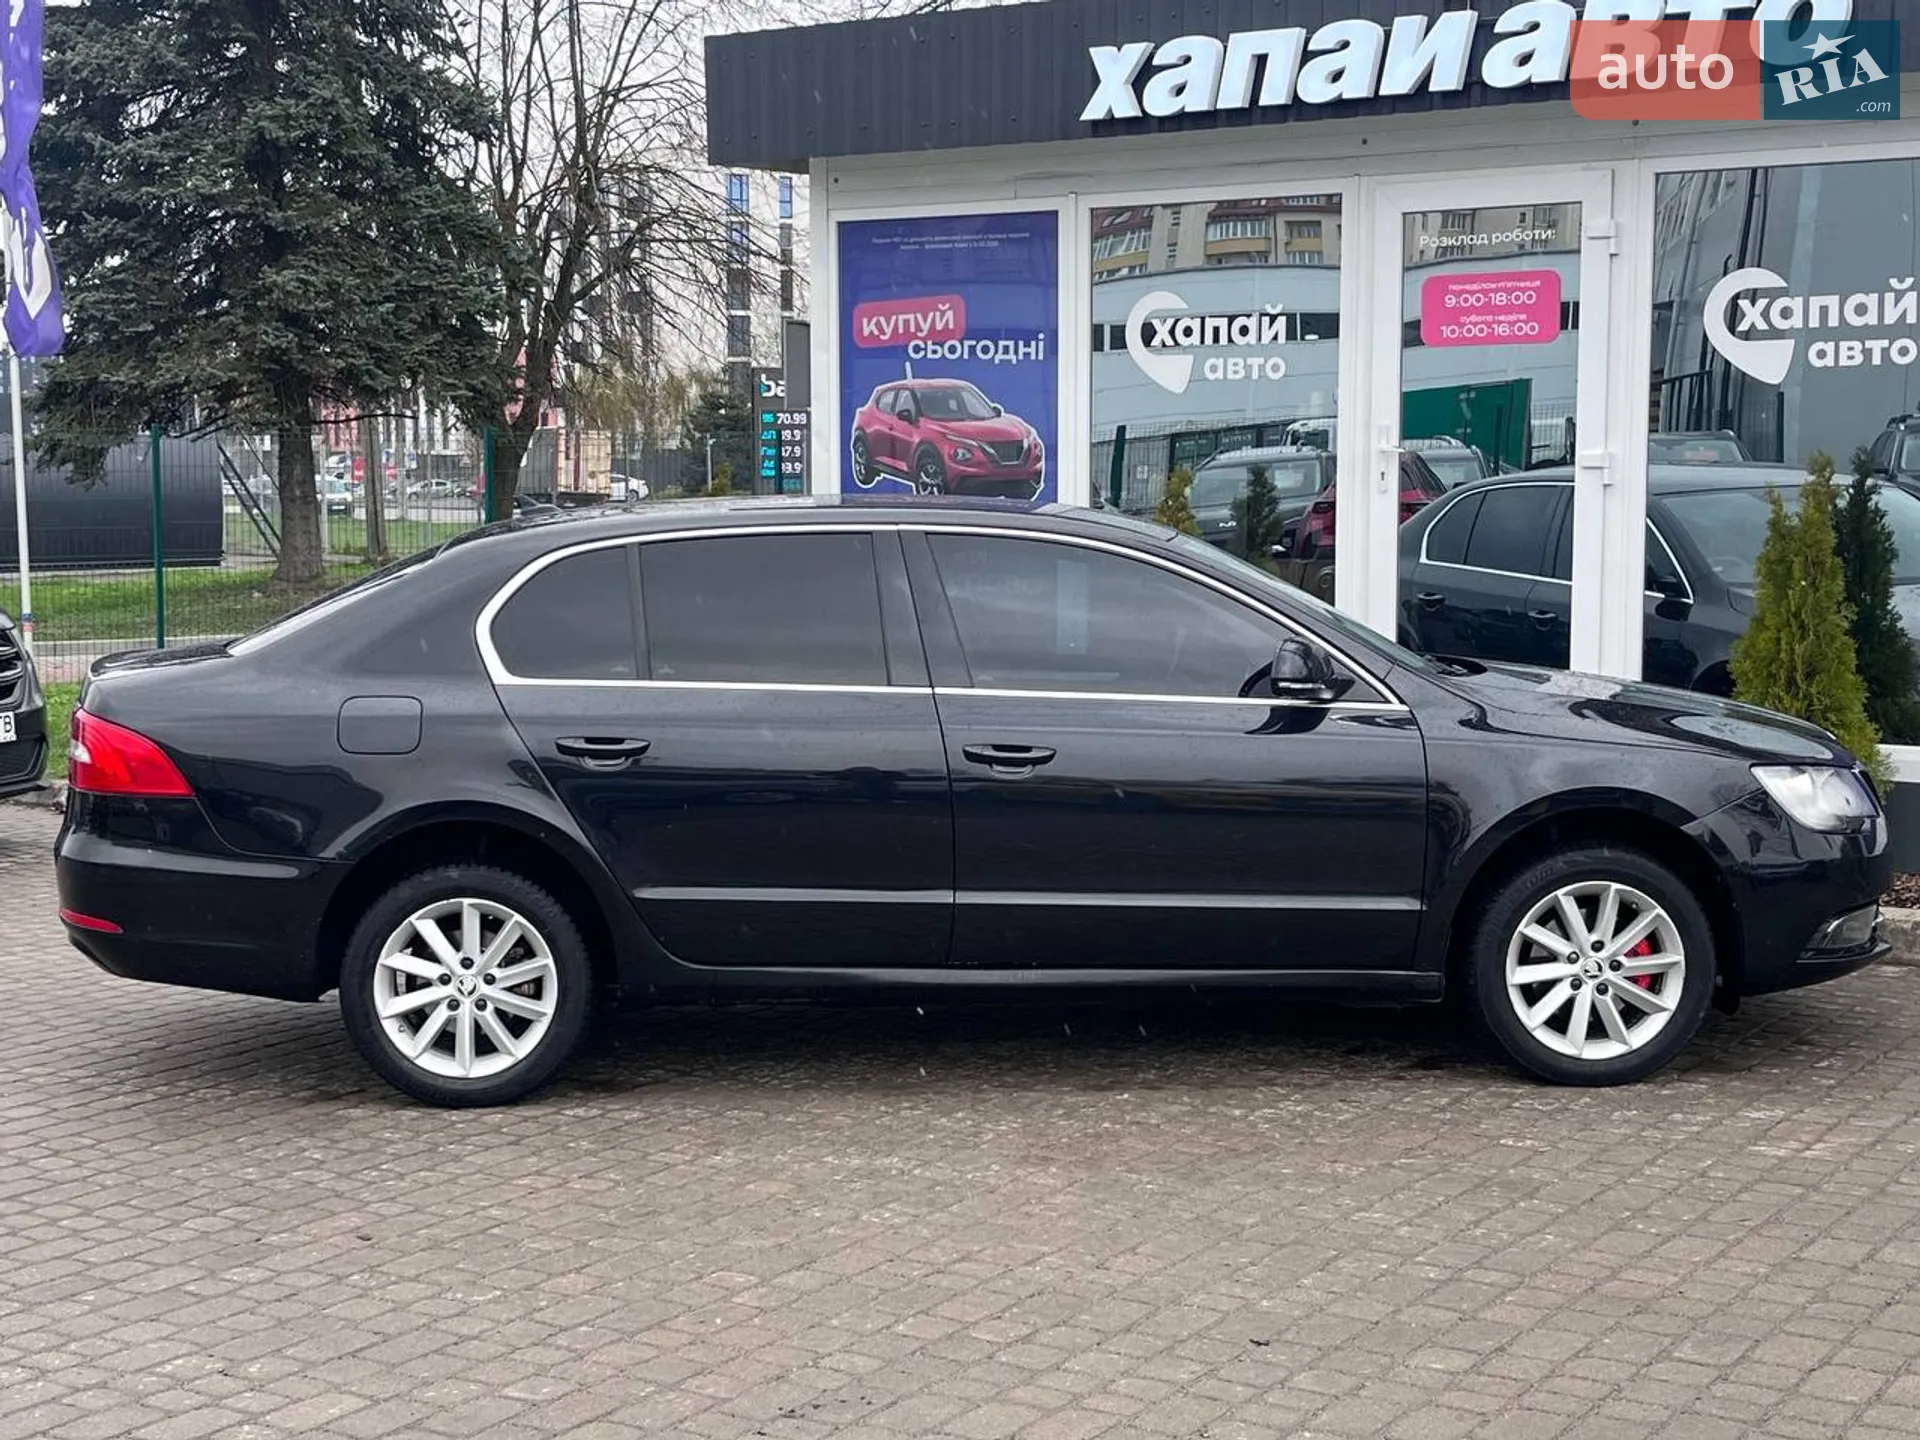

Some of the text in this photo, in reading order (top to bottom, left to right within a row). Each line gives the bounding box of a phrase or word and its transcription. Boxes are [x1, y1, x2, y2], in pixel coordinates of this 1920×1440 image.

[1419, 229, 1556, 248] Розклад роботи:
[1444, 291, 1536, 308] 9:00-18:00
[1737, 277, 1918, 331] хапай
[862, 303, 954, 340] купуй
[1150, 303, 1287, 346] хапай
[1440, 322, 1539, 338] 10:00-16:00
[908, 333, 1045, 364] сьогодні
[1808, 337, 1918, 367] авто
[1204, 356, 1287, 380] авто
[776, 412, 807, 424] 70.99
